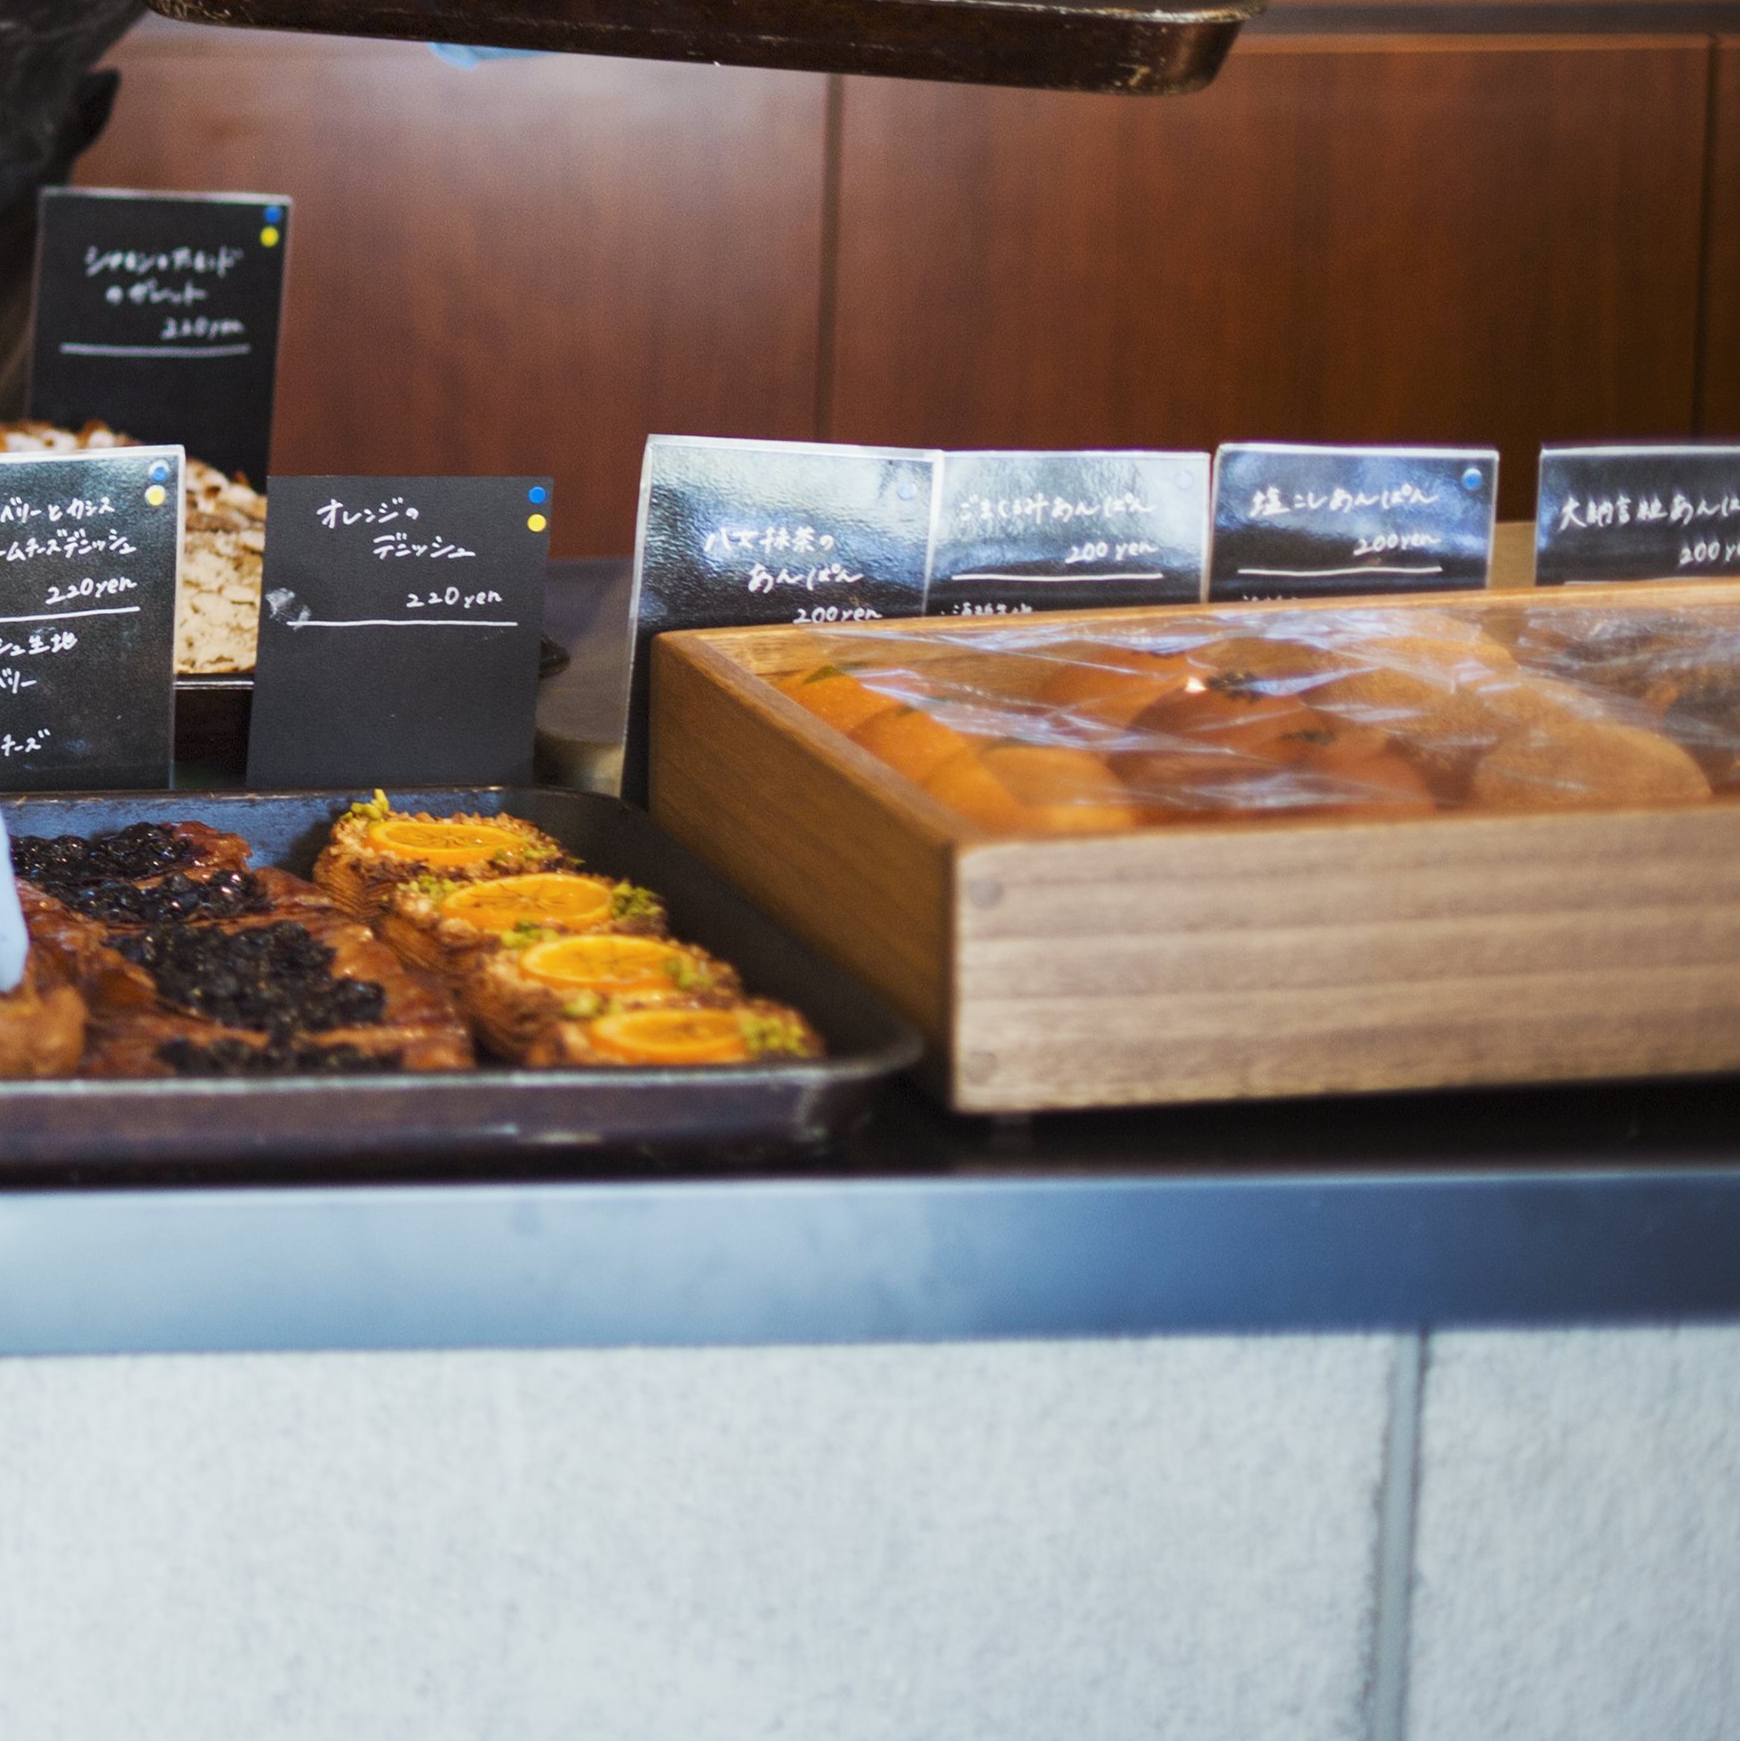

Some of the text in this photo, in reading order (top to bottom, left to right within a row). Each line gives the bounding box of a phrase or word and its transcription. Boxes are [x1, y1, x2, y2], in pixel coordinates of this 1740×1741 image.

[317, 497, 419, 528] オレンジの
[373, 532, 476, 559] デニッシュ
[1353, 533, 1441, 556] 200yen
[45, 577, 137, 605] 220yen
[748, 562, 864, 593] あんぱん
[406, 586, 502, 608] 220yen
[793, 607, 882, 624] 200yen
